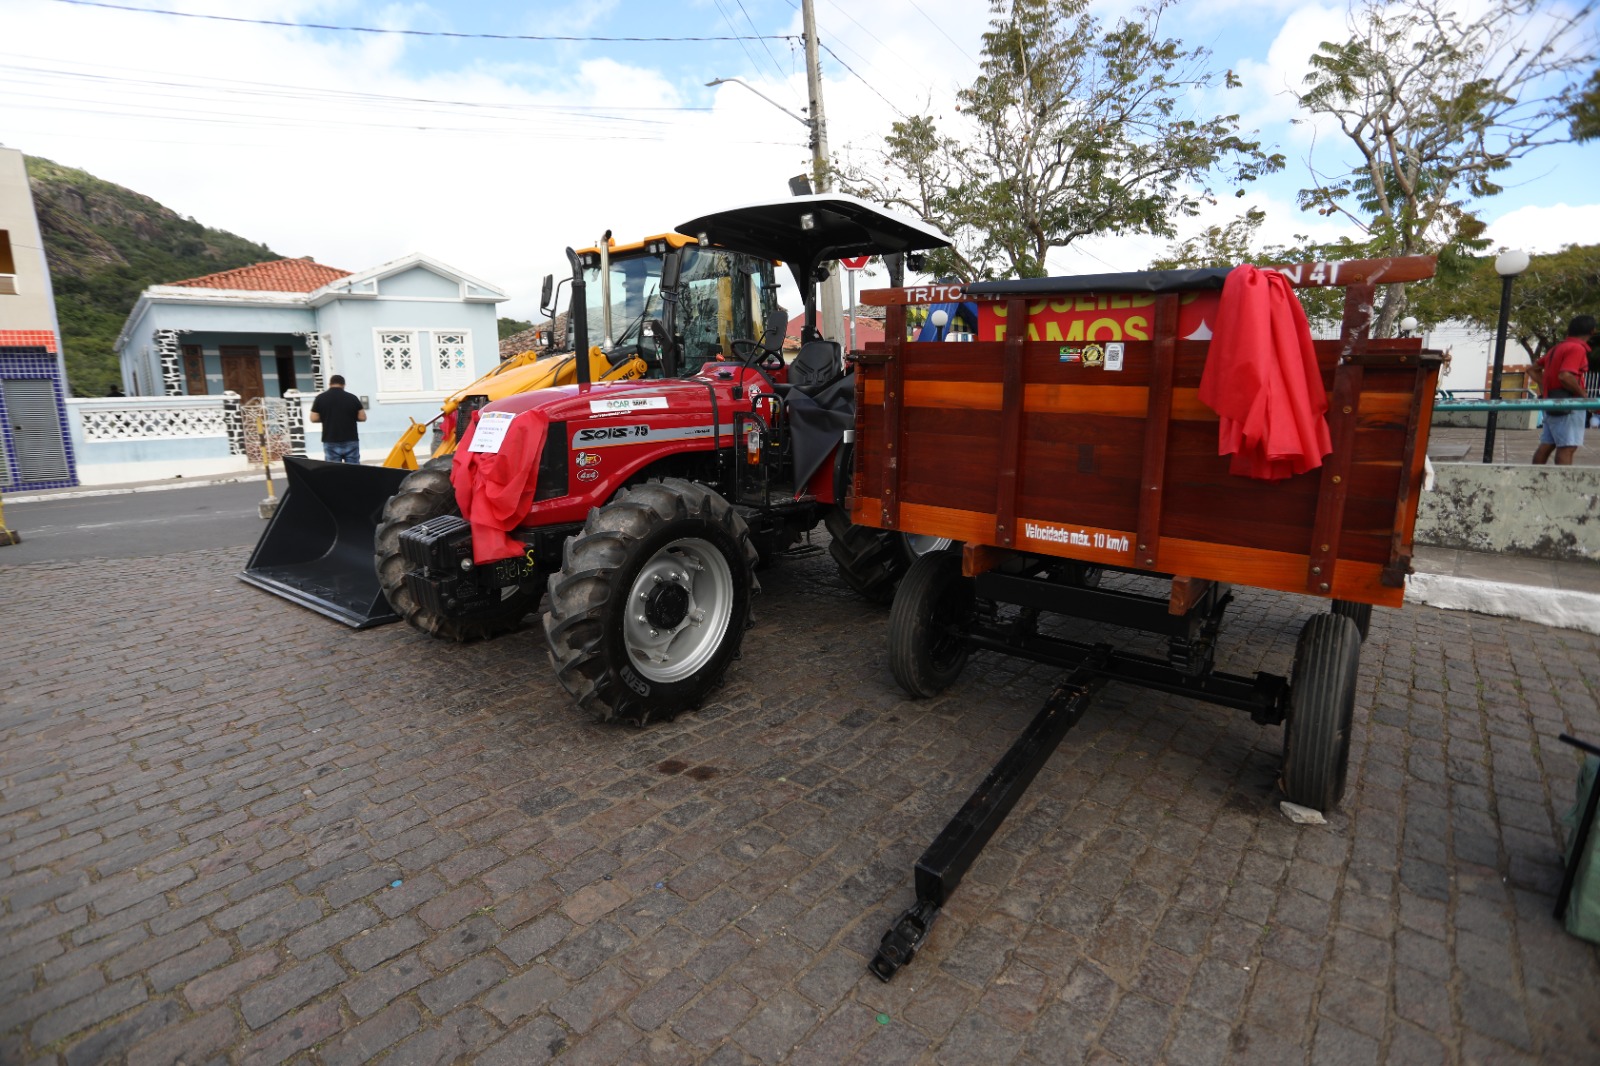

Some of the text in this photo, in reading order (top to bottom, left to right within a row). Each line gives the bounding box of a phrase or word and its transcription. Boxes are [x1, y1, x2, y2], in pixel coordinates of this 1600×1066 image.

[1309, 260, 1344, 285] 4T
[613, 400, 630, 408] CAR
[1025, 523, 1129, 553] Velocidade máx. 10 km/h
